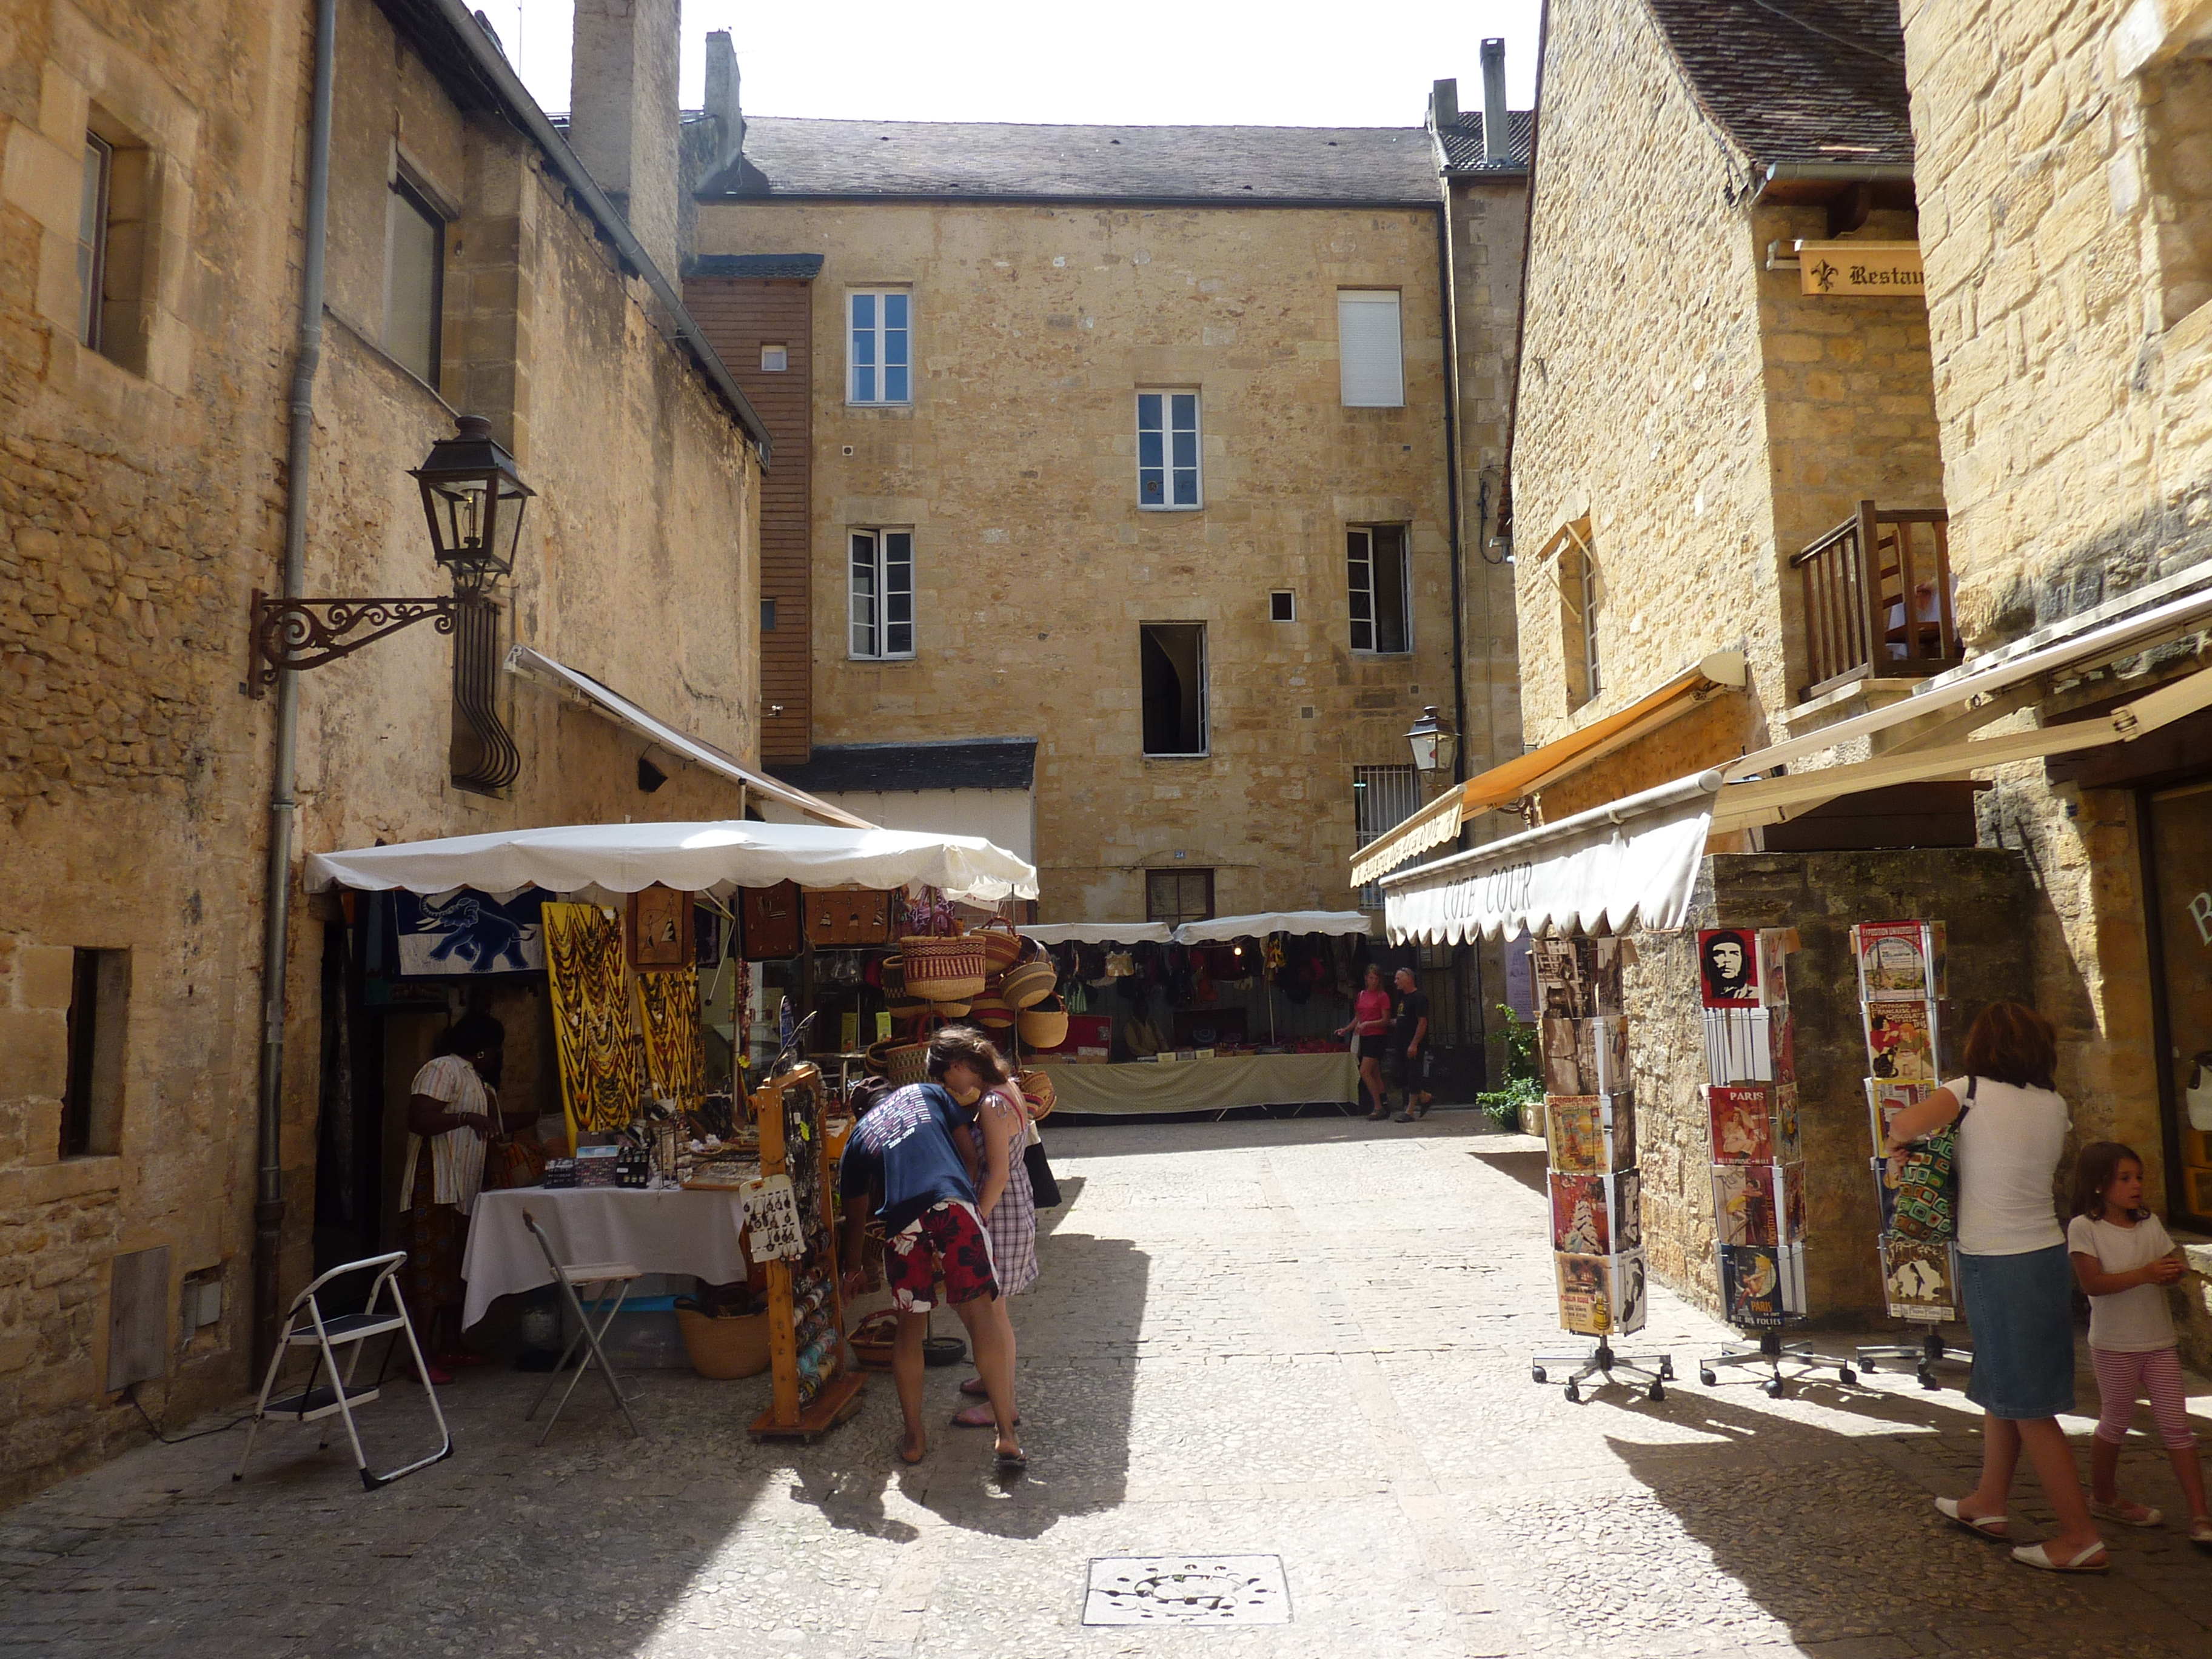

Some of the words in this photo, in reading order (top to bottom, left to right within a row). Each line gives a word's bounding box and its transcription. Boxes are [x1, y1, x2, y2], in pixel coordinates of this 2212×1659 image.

[1486, 861, 1531, 914] COUR
[1730, 1092, 1765, 1101] PARIS
[1751, 1301, 1773, 1312] PARIS
